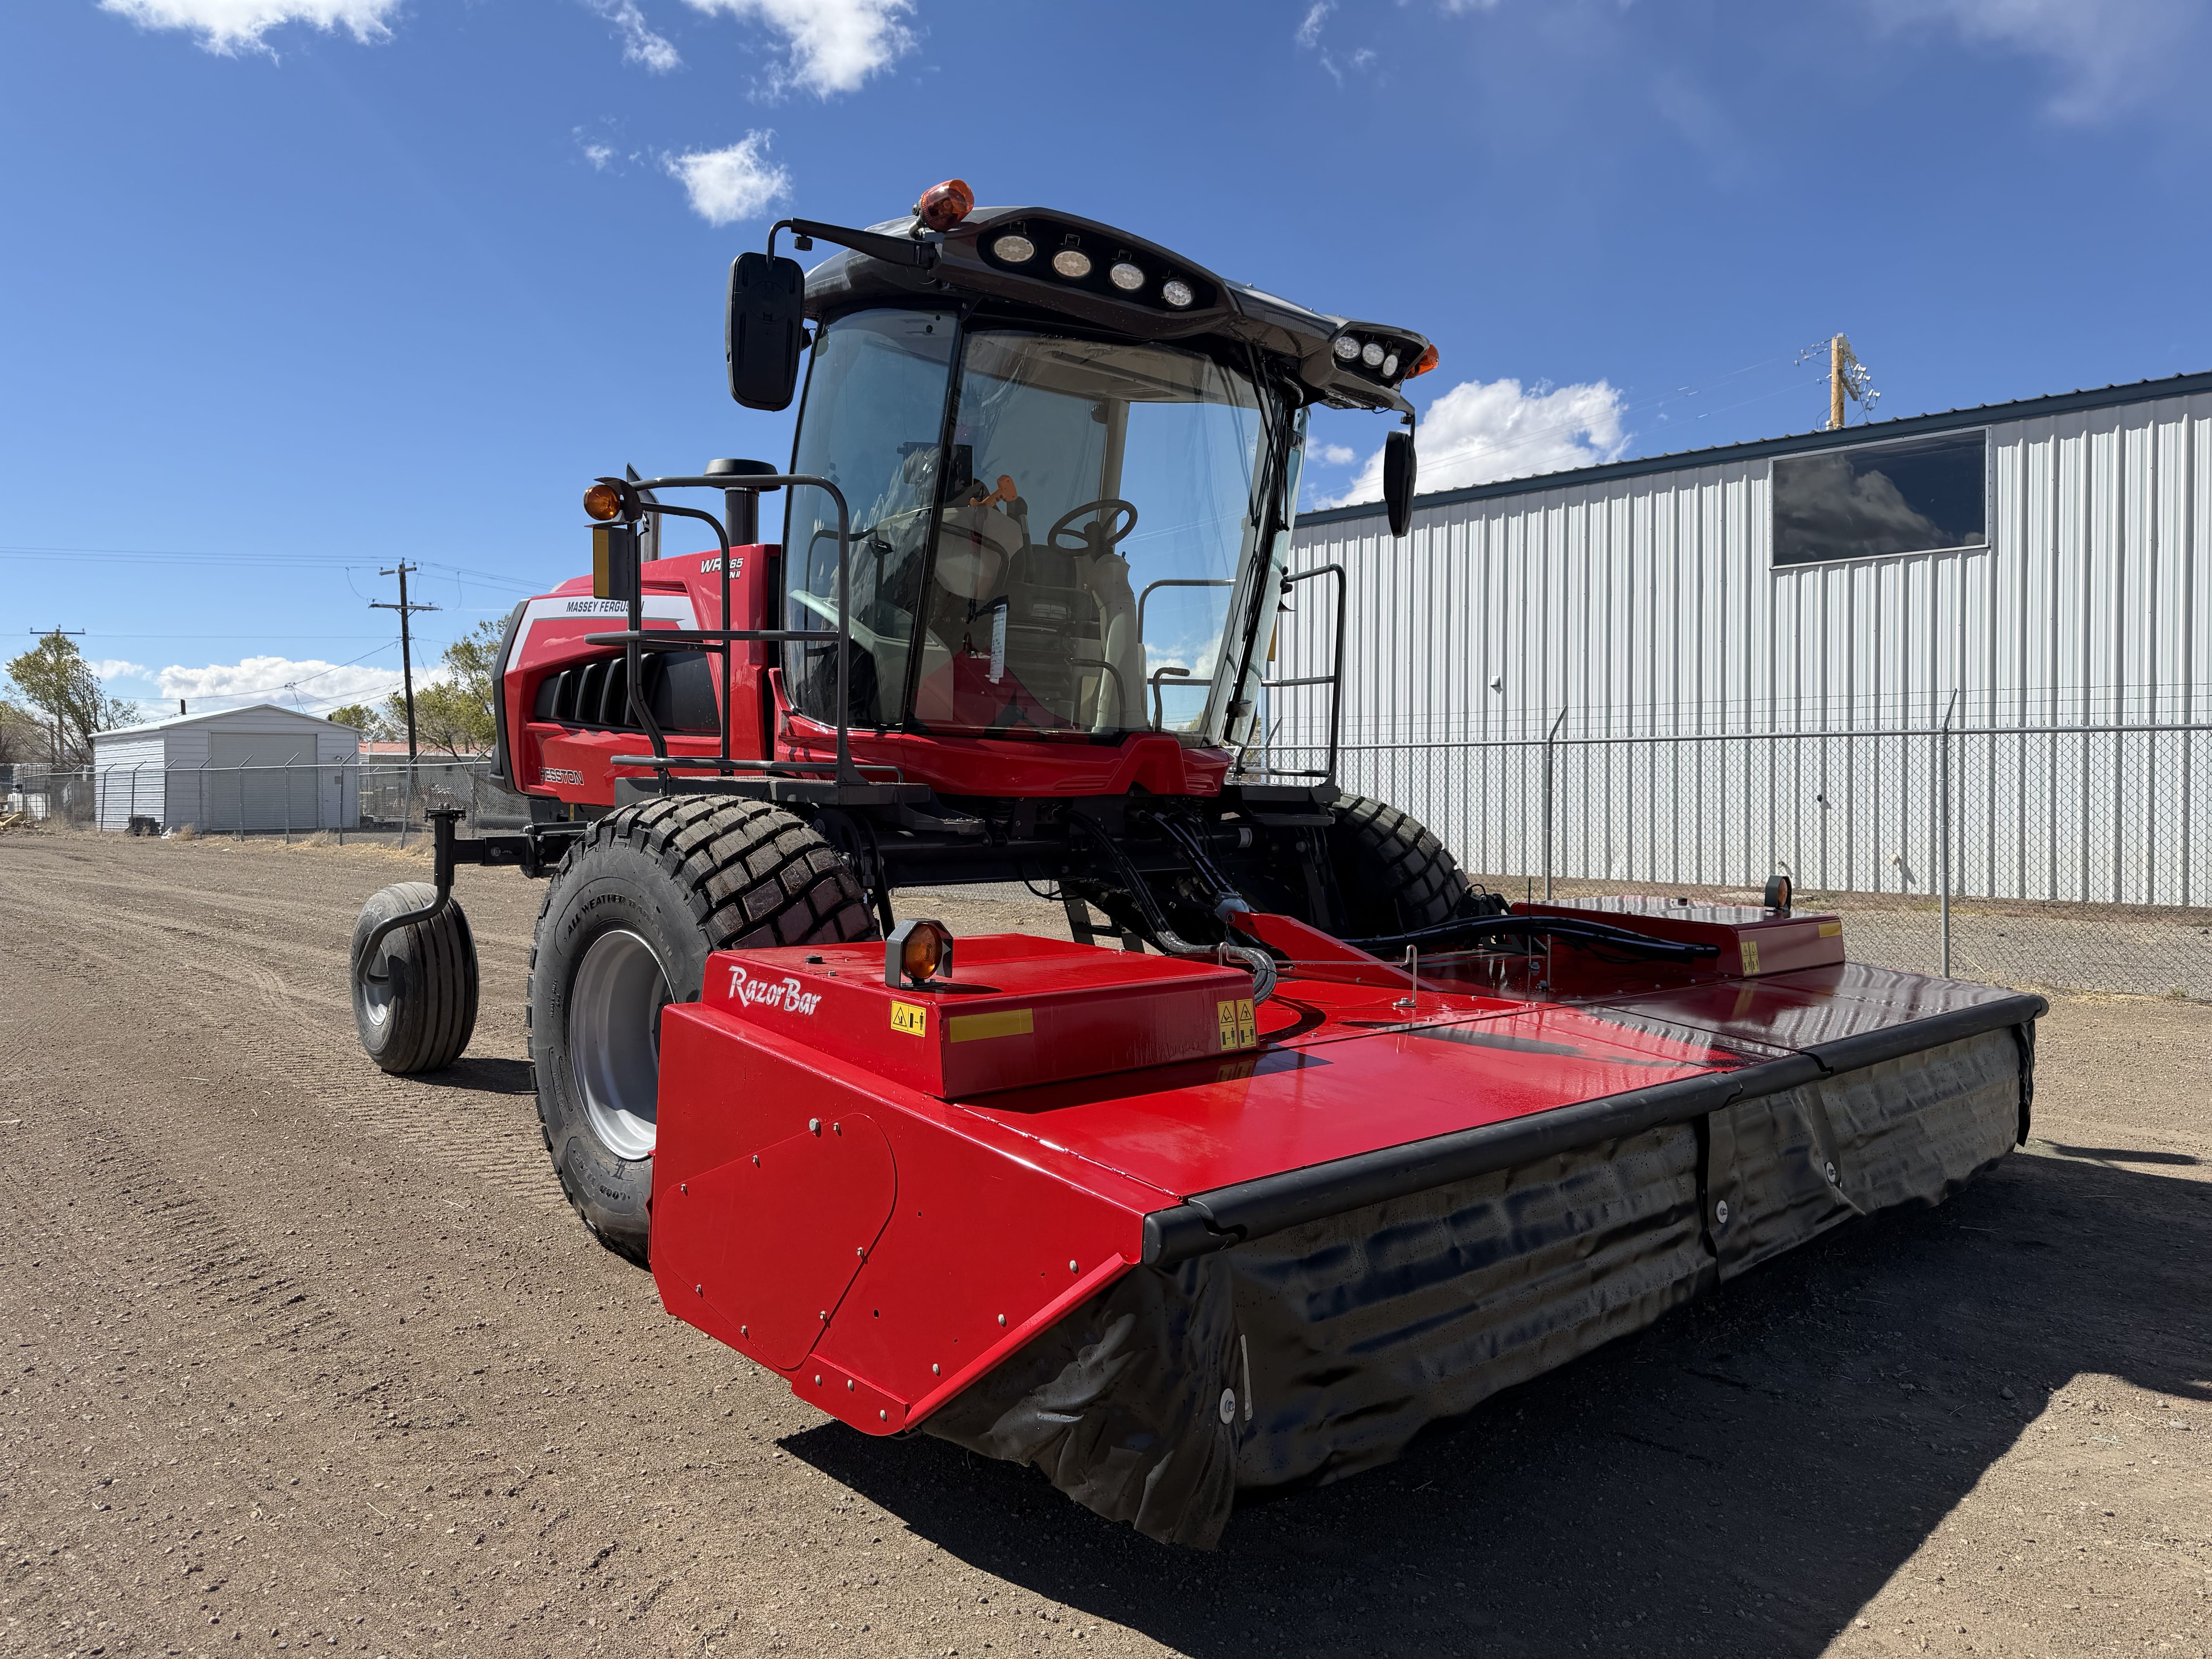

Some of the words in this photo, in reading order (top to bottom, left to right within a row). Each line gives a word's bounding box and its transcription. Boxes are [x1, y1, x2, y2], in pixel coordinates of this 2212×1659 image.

[701, 557, 744, 574] WR65
[566, 601, 598, 612] MASSEY
[538, 766, 584, 786] HESSTON
[568, 913, 581, 938] ALL
[581, 893, 626, 914] WEATHER
